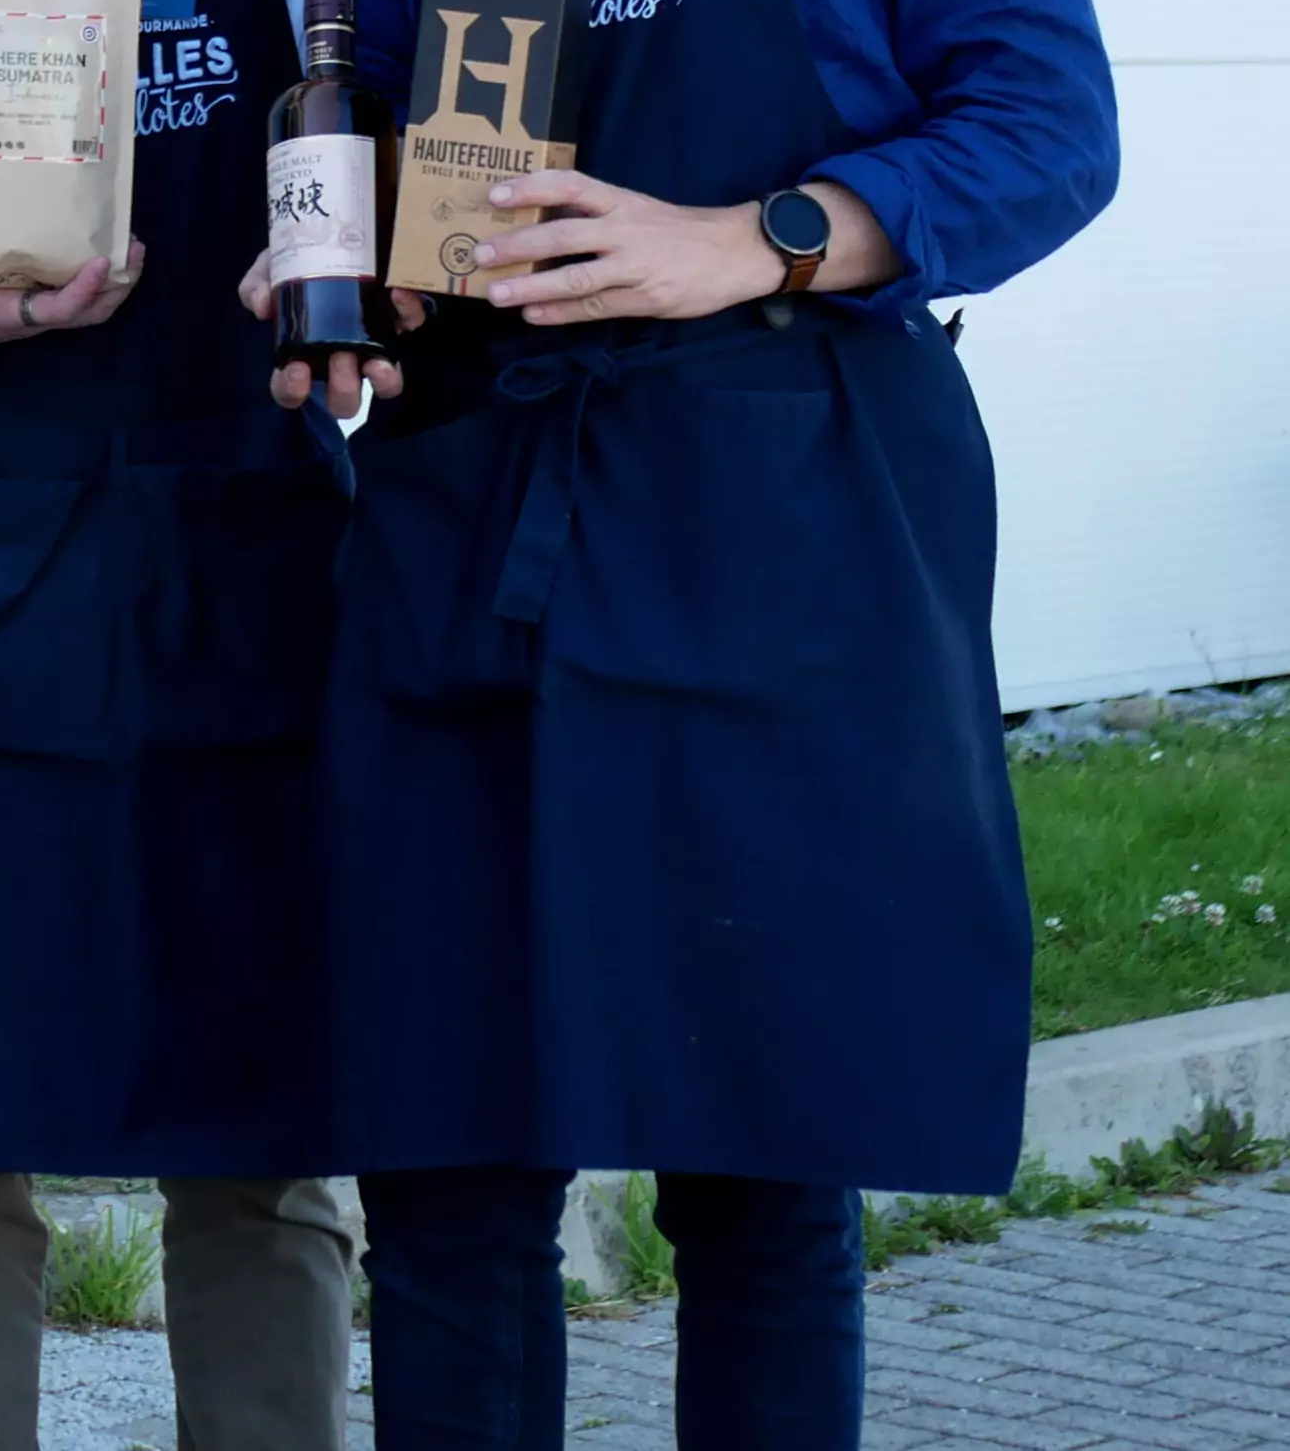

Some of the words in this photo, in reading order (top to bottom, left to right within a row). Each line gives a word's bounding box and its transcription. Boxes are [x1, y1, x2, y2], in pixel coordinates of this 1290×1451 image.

[42, 52, 87, 68] KHAN
[413, 136, 534, 174] HAUTEFEUILLE
[422, 164, 454, 179] SINGLE
[458, 170, 481, 181] MALT
